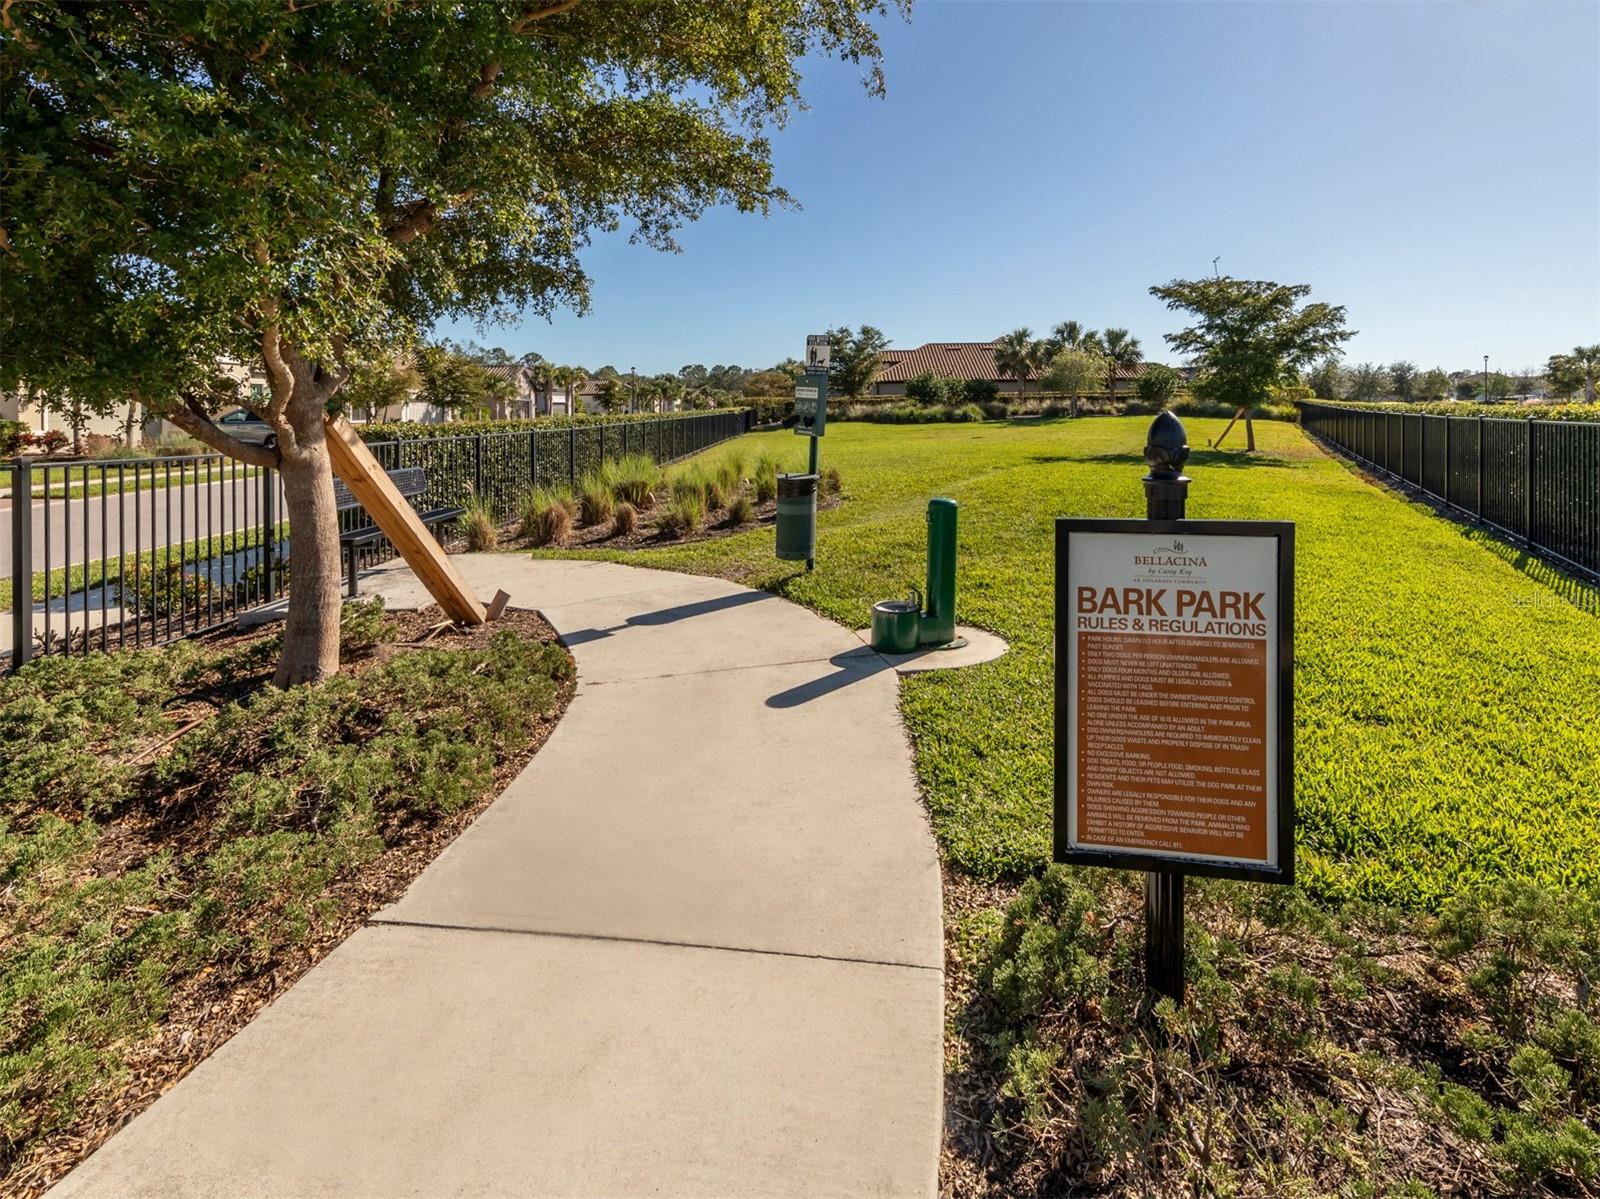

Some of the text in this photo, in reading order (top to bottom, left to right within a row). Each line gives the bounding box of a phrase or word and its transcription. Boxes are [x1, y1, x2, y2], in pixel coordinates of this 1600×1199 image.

[1134, 556, 1208, 567] BELLACINA
[1078, 586, 1266, 620] BARK PARK
[1078, 617, 1266, 636] RULES & REGULATIONS
